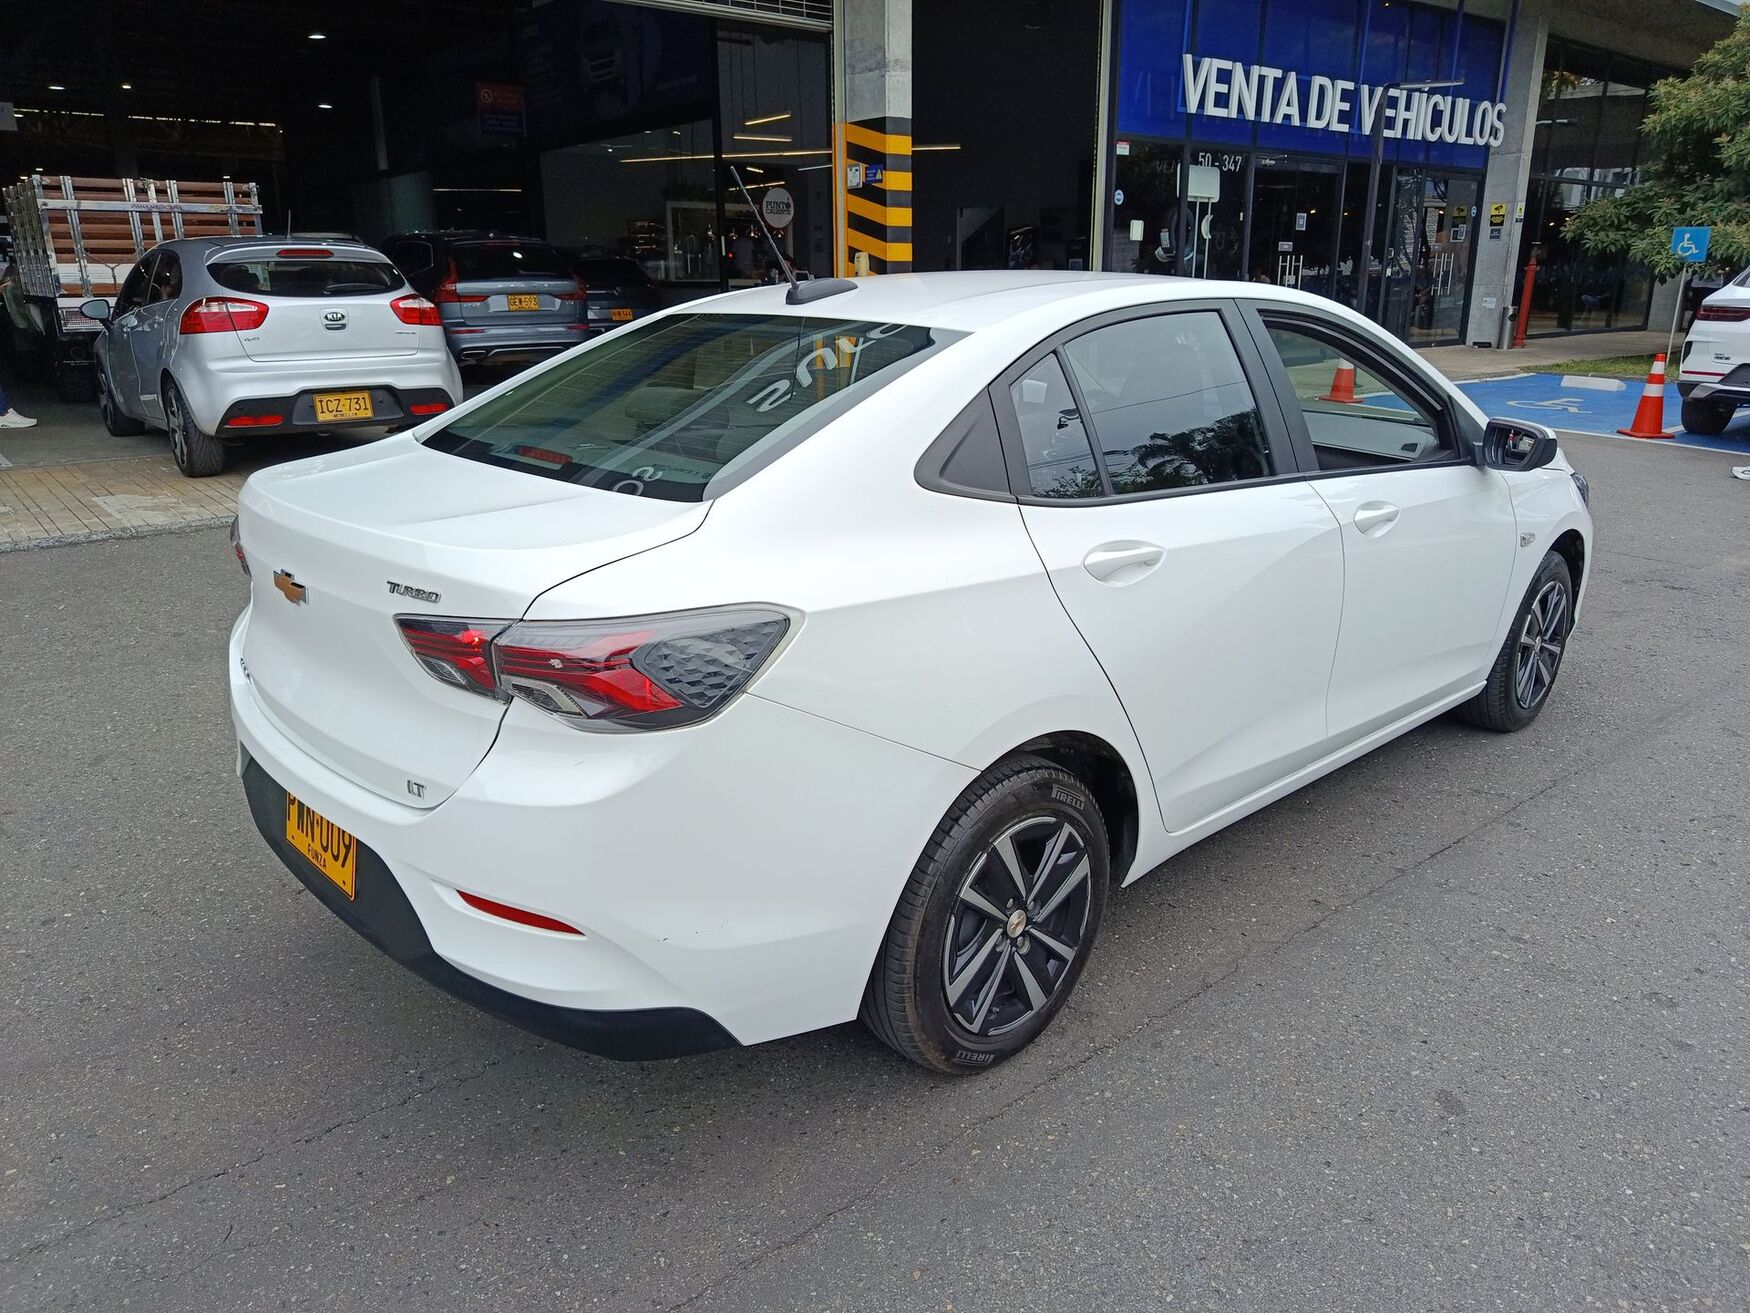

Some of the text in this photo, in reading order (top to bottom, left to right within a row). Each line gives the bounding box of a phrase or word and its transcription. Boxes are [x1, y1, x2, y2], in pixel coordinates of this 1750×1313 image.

[1182, 53, 1507, 147] VENTA DE VEHÍCULOS
[1198, 152, 1212, 168] 50
[1222, 154, 1242, 172] 347
[327, 313, 342, 321] KIA
[387, 580, 442, 604] TURBO
[407, 780, 425, 799] LT
[1051, 784, 1086, 811] PIRELLI
[307, 843, 327, 870] FUNZA
